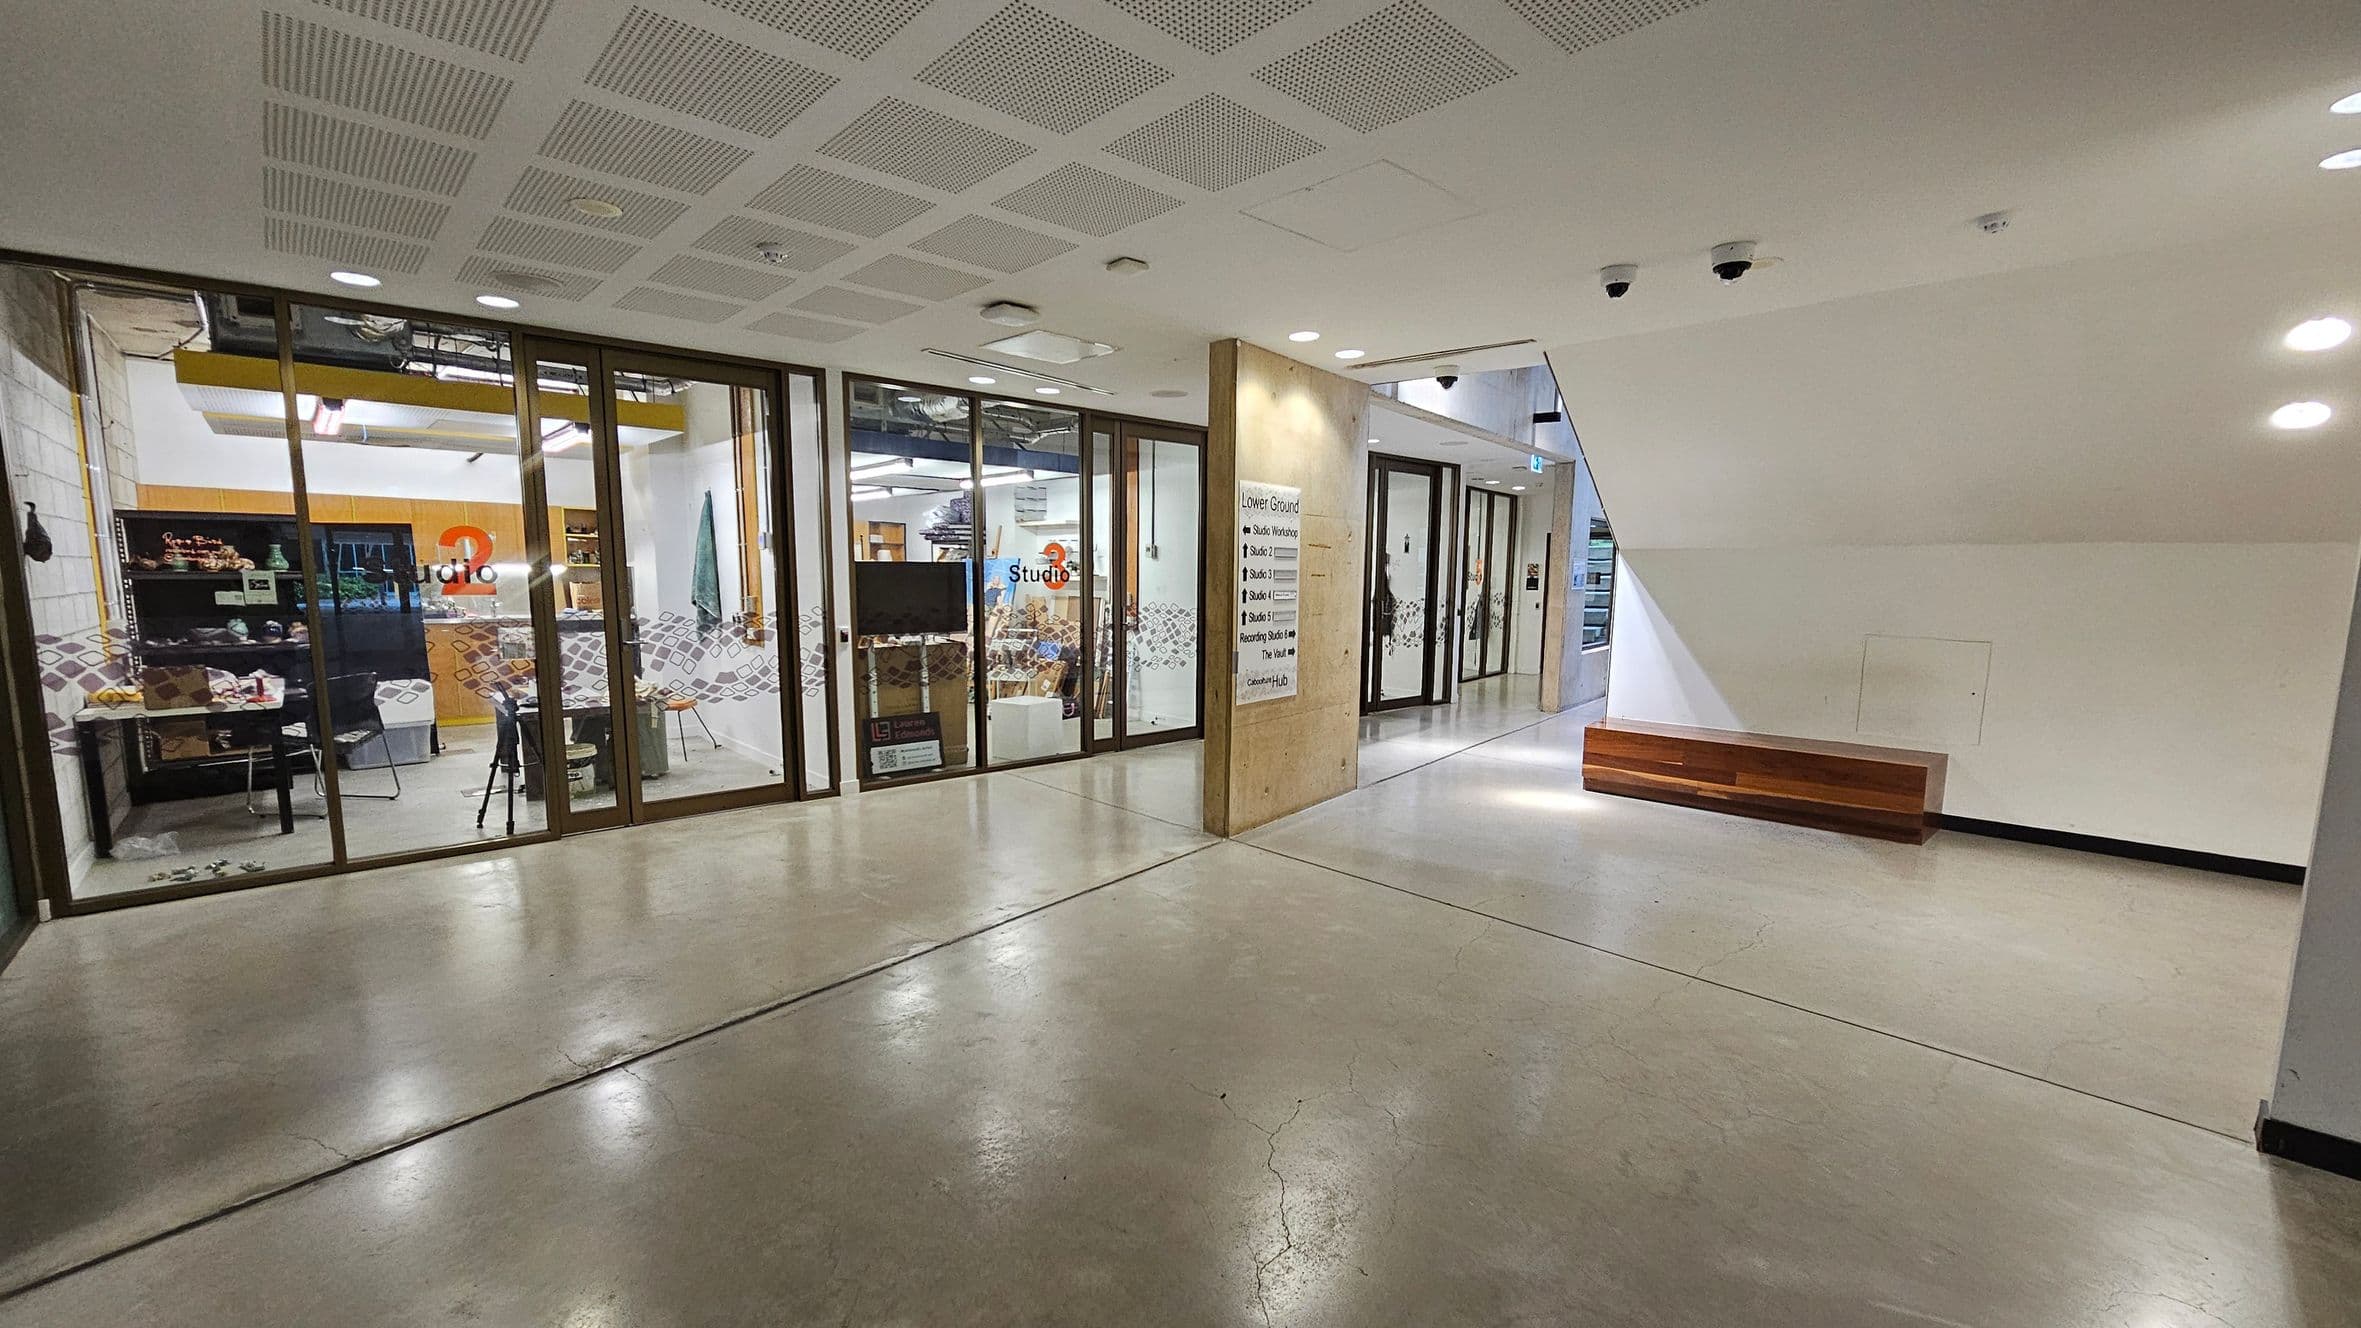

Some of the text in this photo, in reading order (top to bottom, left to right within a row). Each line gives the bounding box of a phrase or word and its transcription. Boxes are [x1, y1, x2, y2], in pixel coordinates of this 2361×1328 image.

[1241, 491, 1299, 513] Lower Ground
[1252, 524, 1298, 539] Studio Workshop
[1249, 545, 1273, 557] Studio 2
[438, 525, 494, 595] 2
[1009, 542, 1070, 590] Studio 3
[1249, 568, 1272, 579] Studio 3
[1249, 590, 1267, 600] Studio
[1267, 590, 1272, 599] 4
[1248, 611, 1272, 623] Studio 5
[1239, 632, 1267, 644] Recording
[1268, 630, 1284, 641] Studio
[1262, 648, 1287, 660] The Vault
[1272, 674, 1289, 688] Hub
[894, 719, 927, 729] Lauren
[894, 728, 936, 740] Edmonds
